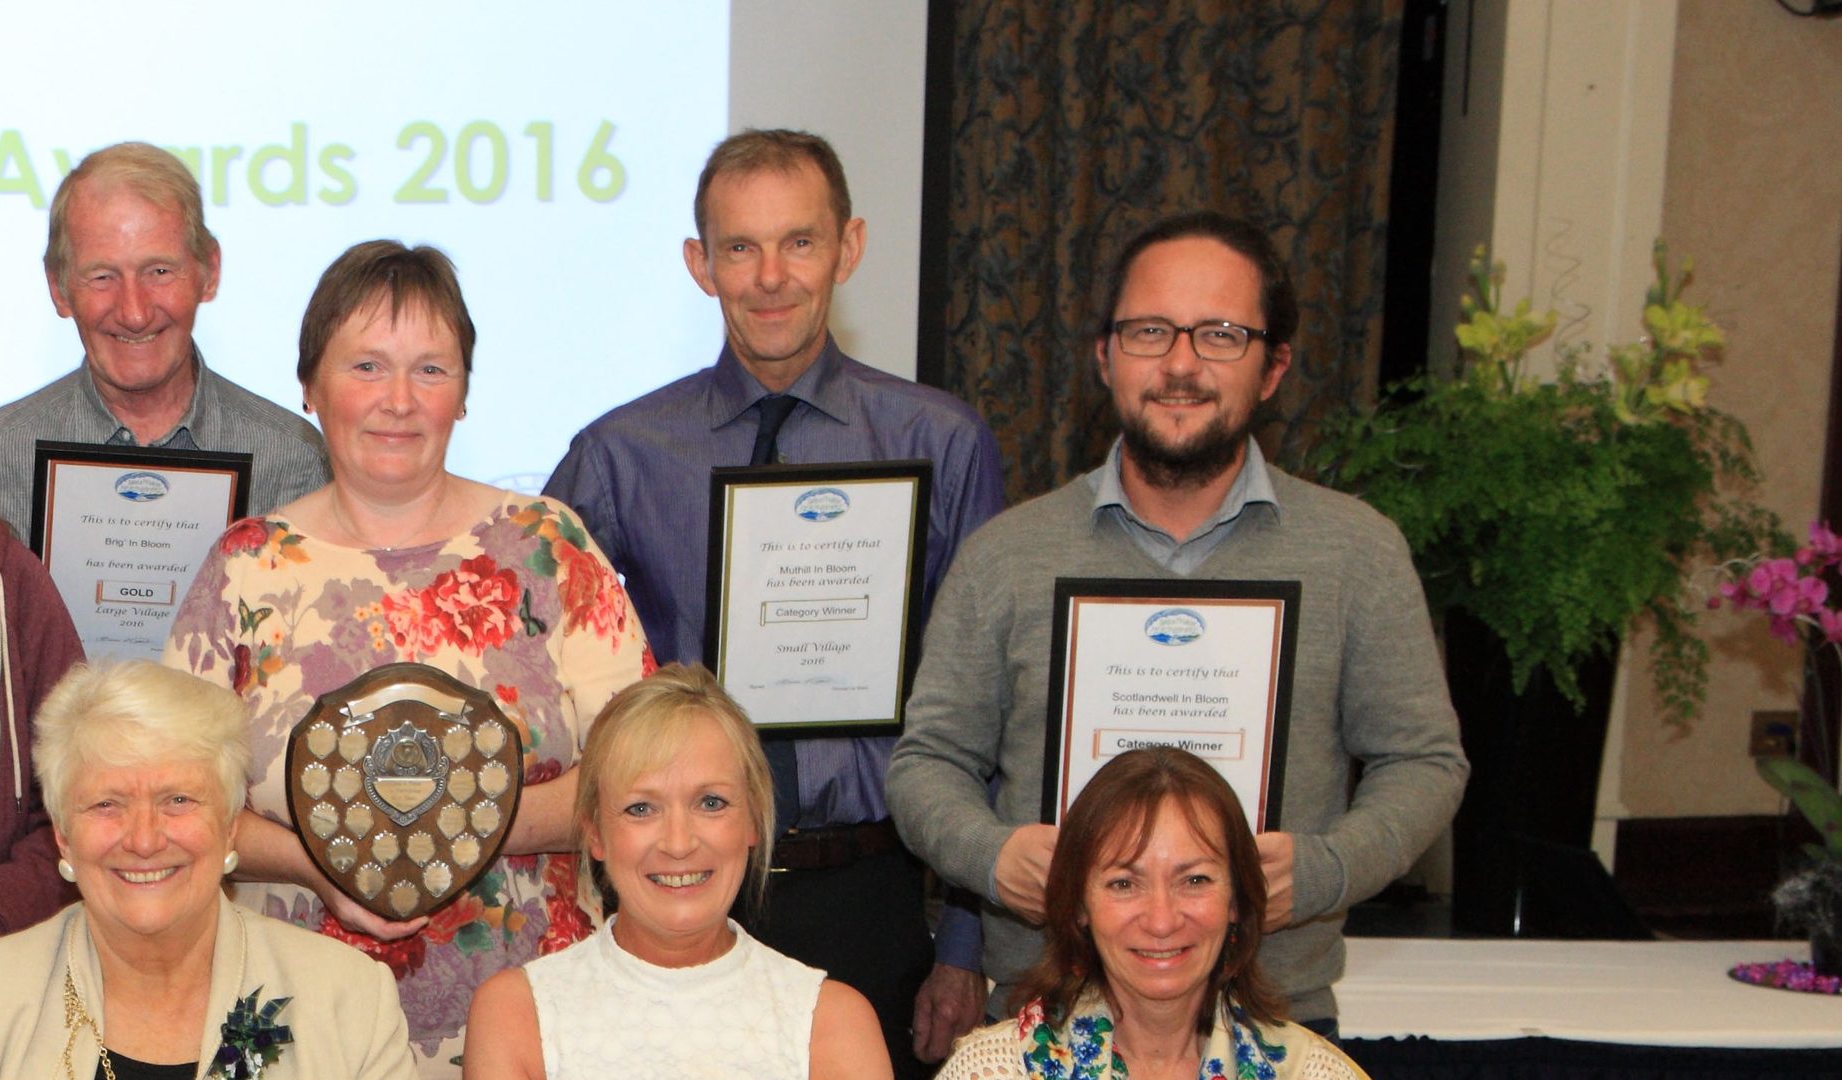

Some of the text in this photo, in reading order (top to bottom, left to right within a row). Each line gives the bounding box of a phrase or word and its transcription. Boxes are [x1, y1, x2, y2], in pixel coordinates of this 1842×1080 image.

[393, 119, 628, 206] 2016
[80, 515, 200, 530] This is to certify that
[129, 539, 138, 547] In
[140, 540, 171, 549] Bloom
[761, 539, 881, 552] This is to certify that
[86, 559, 189, 573] has been awarded
[779, 564, 856, 574] Muthill In Bloom
[767, 575, 870, 588] has been awarded
[120, 587, 154, 597] GOLD
[95, 606, 170, 619] Large Village
[776, 607, 856, 619] Category Winner
[776, 642, 851, 654] Small Village
[800, 658, 825, 666] 2016
[1106, 664, 1239, 679] This is to certify that
[1112, 692, 1229, 704] Scotlandwell In Bloom
[1113, 705, 1229, 718] has been awarded
[1178, 740, 1223, 751] Winner
